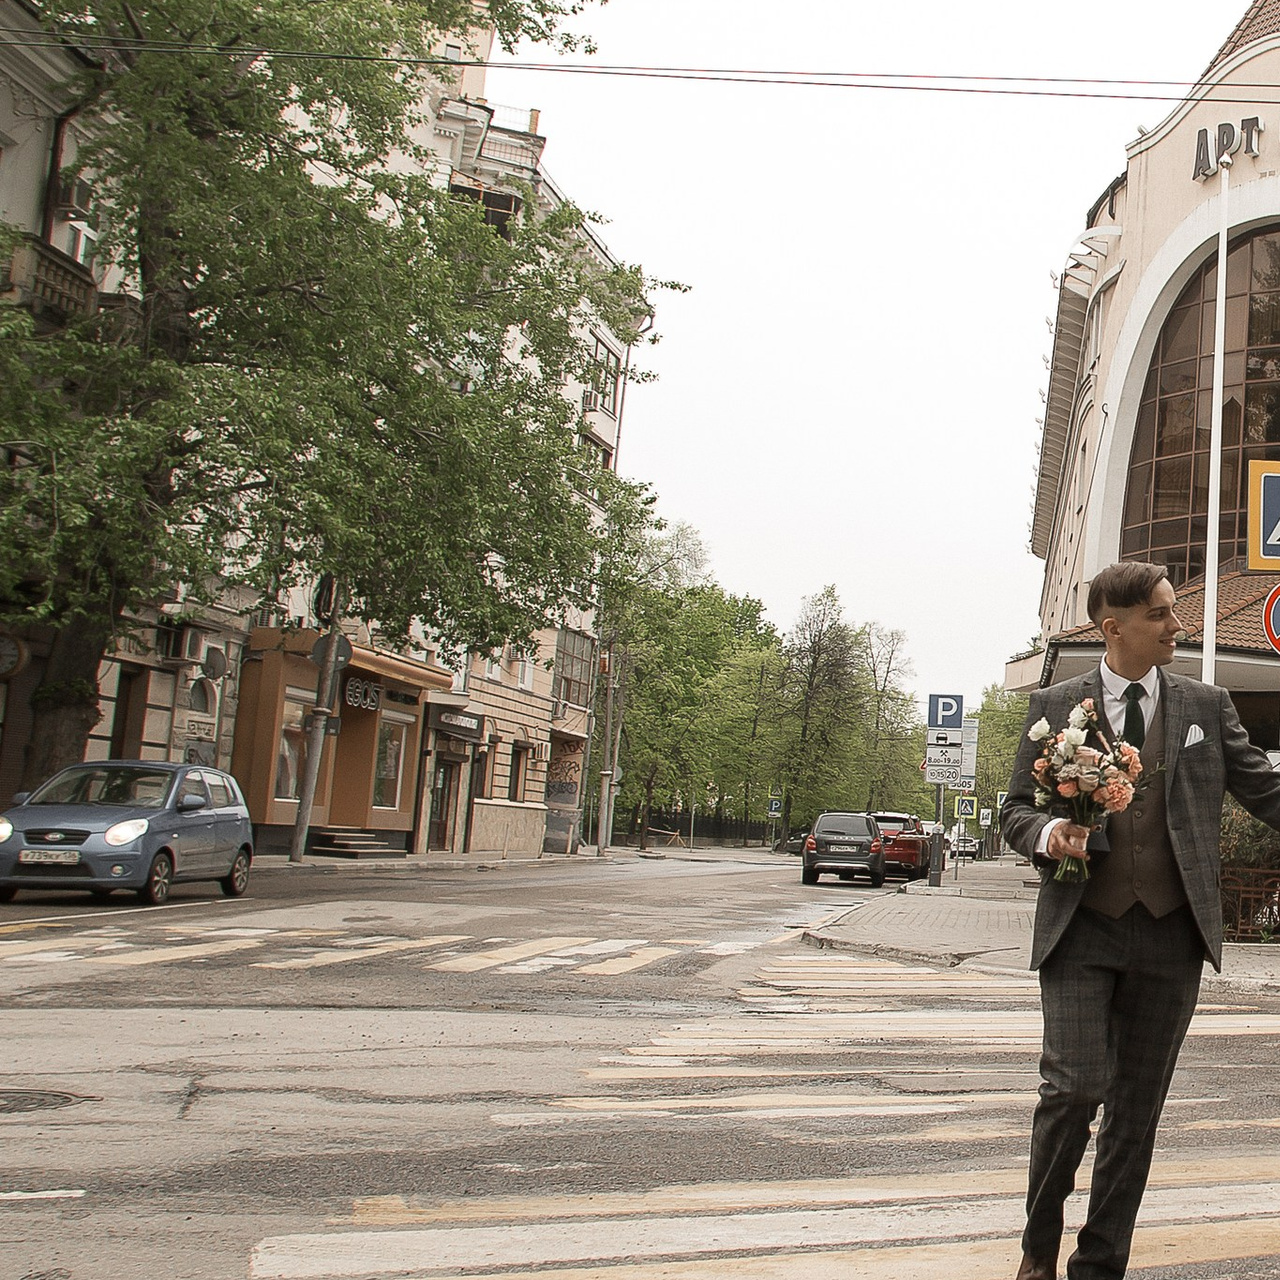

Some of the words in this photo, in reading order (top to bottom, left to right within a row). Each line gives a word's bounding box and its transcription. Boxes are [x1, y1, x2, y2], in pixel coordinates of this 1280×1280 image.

[1192, 116, 1264, 183] АРТ
[938, 698, 957, 724] P
[946, 770, 957, 779] 20
